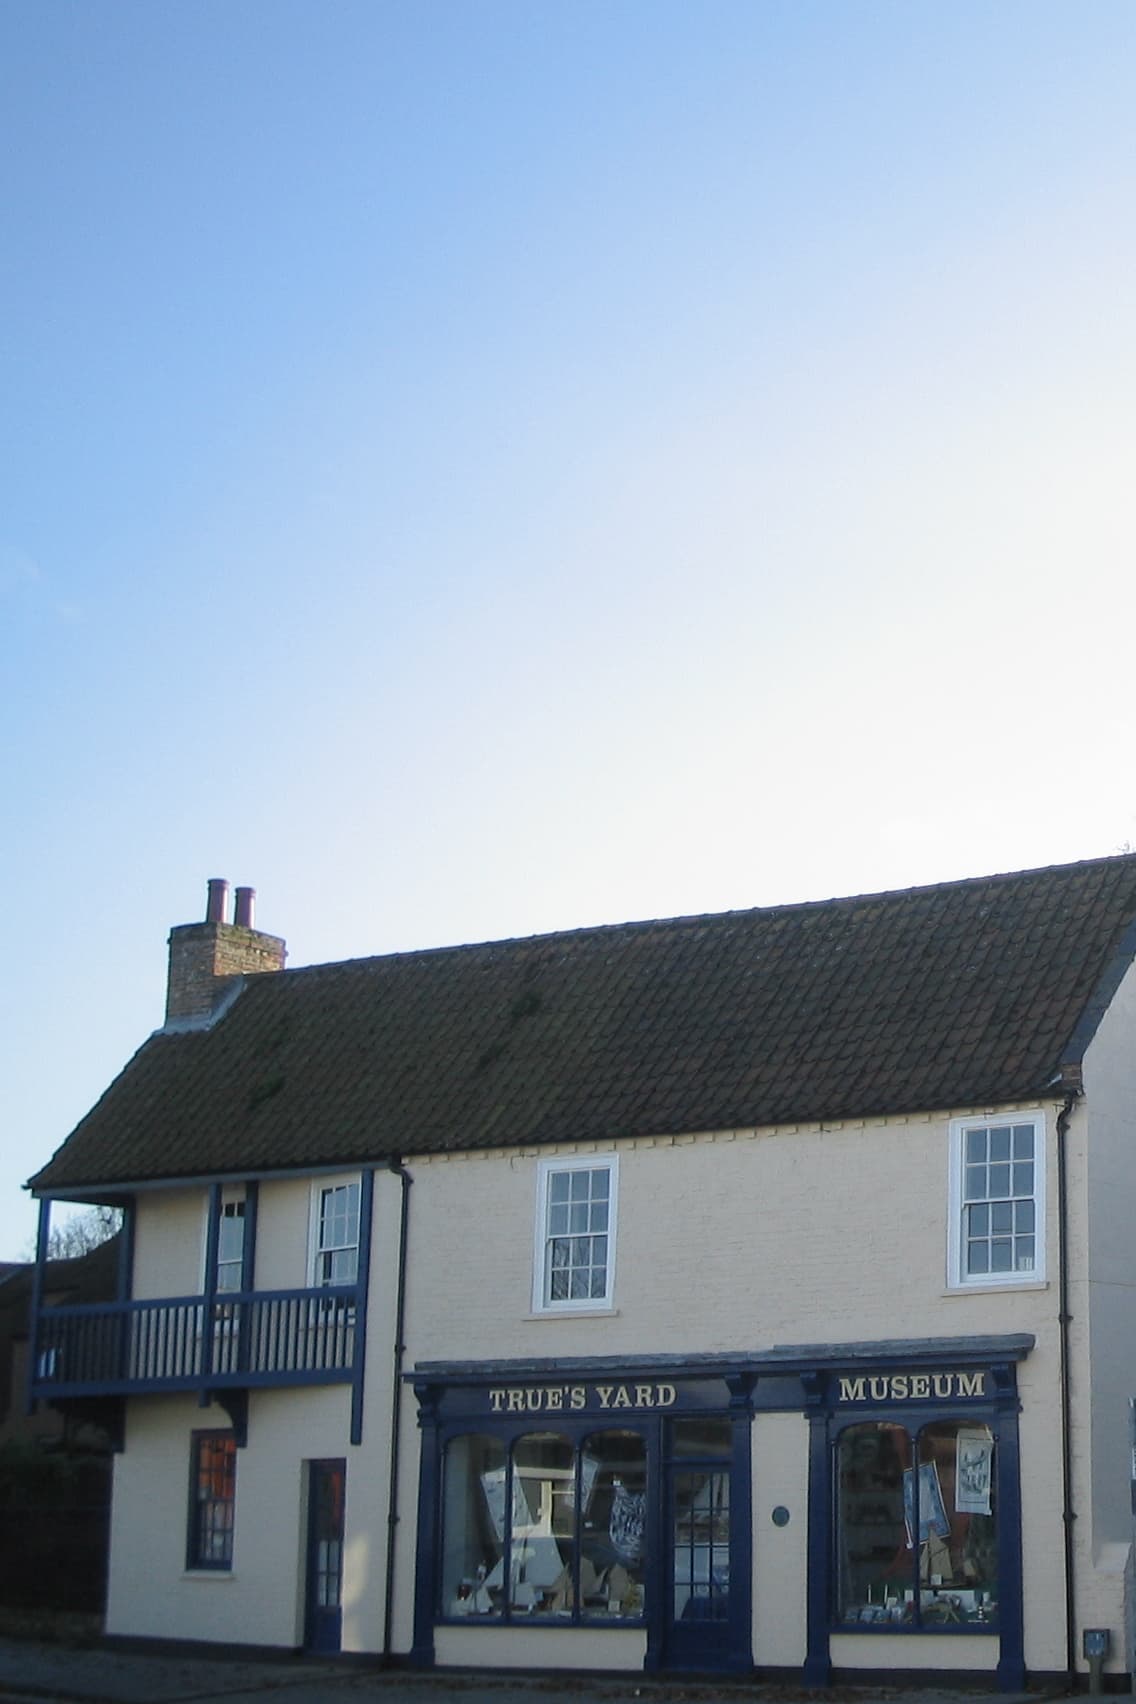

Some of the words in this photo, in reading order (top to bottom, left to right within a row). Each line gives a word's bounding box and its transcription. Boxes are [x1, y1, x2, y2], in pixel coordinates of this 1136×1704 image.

[489, 1386, 586, 1411] TRUE'S
[596, 1384, 676, 1408] YARD
[839, 1373, 985, 1401] MUSEUM
